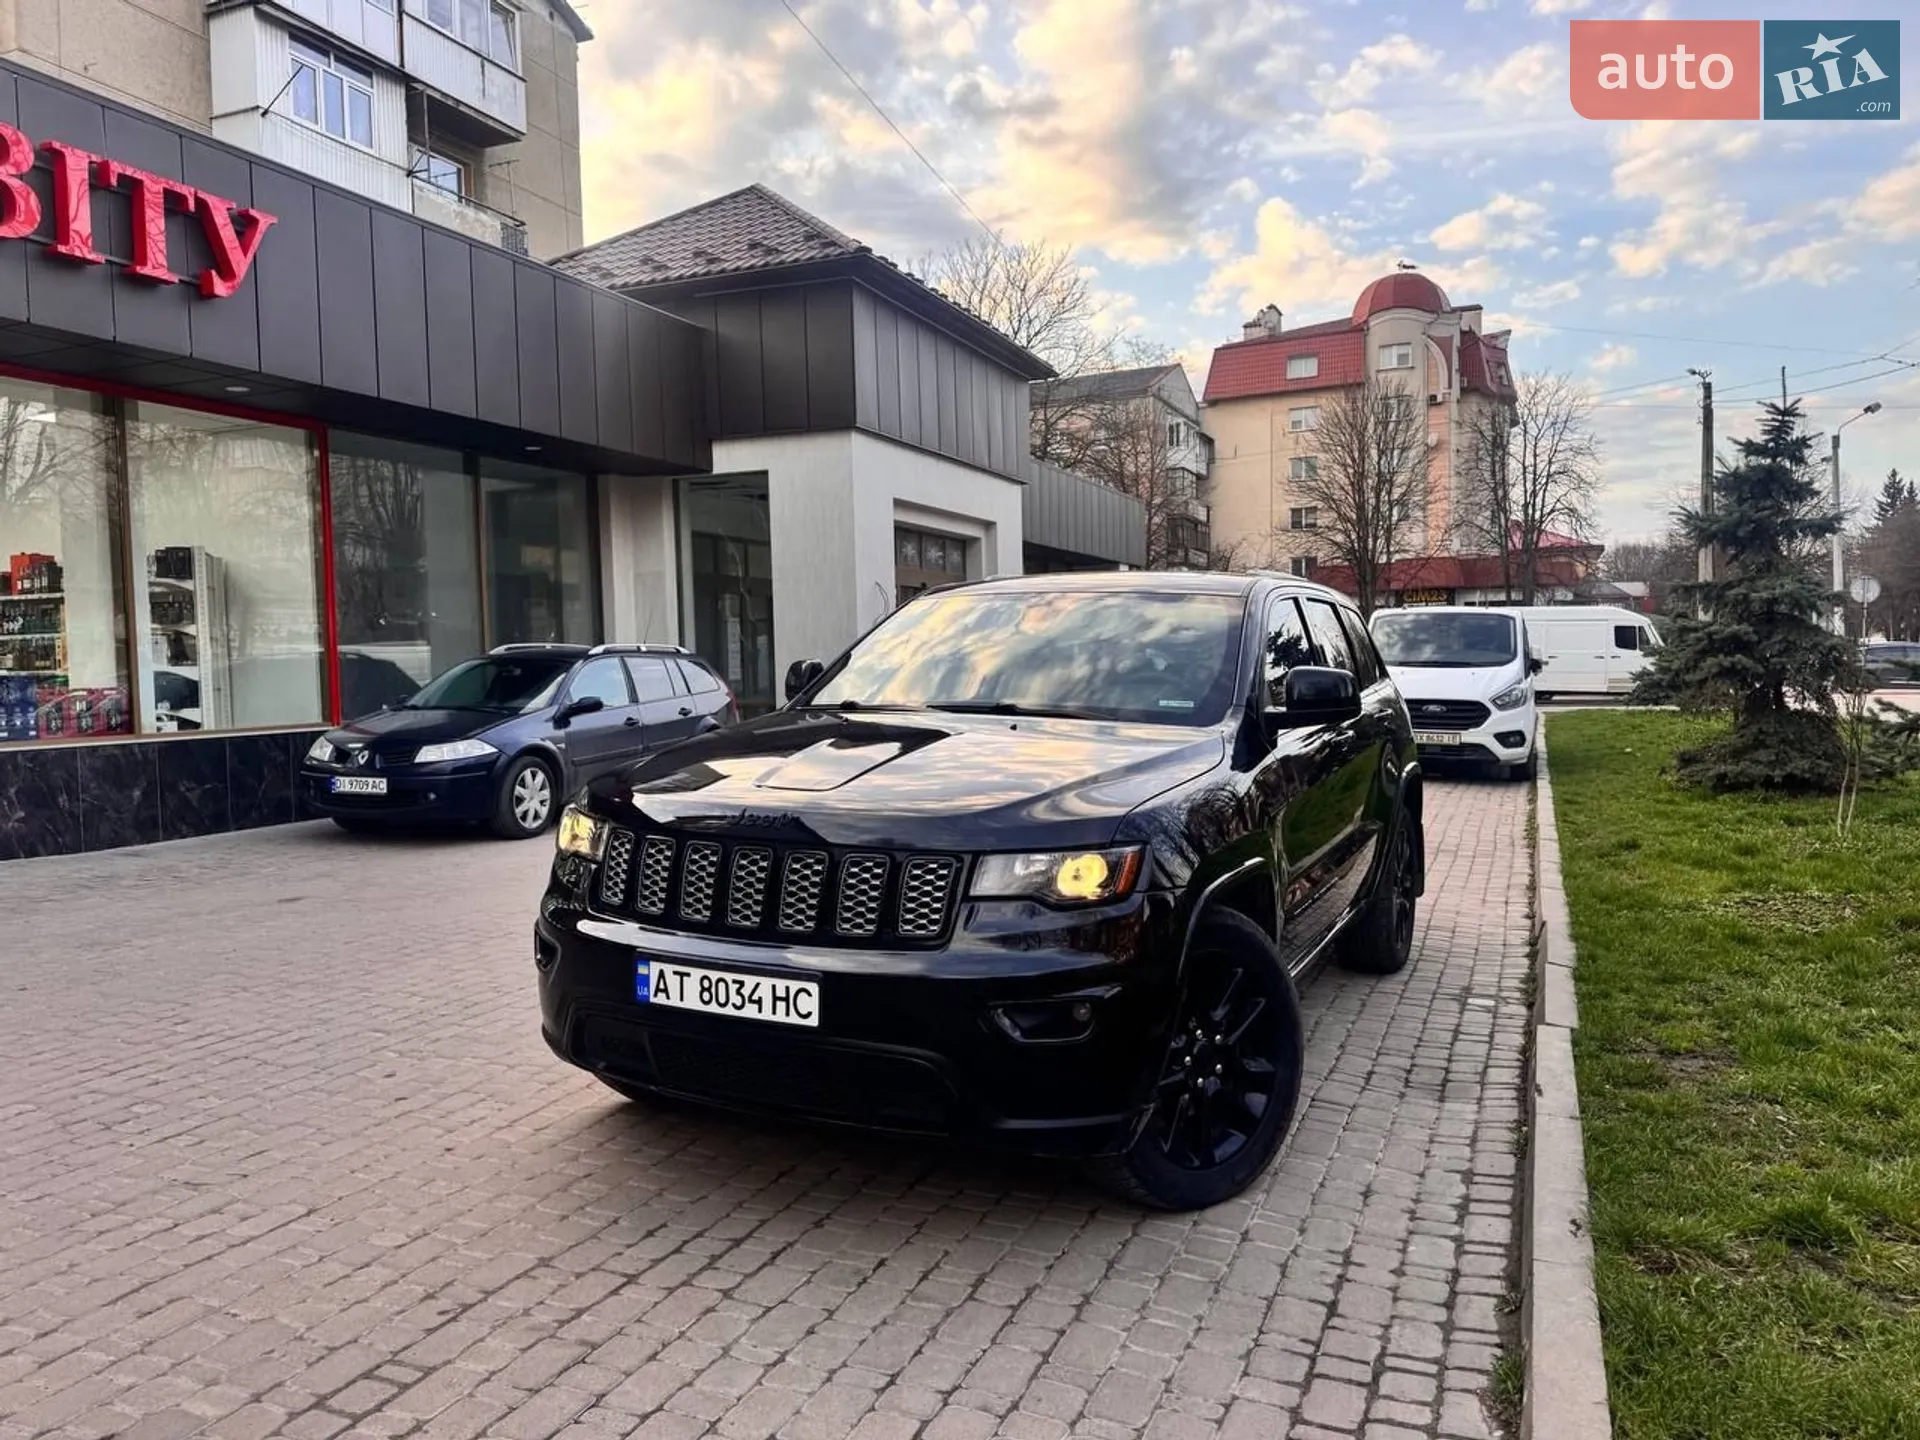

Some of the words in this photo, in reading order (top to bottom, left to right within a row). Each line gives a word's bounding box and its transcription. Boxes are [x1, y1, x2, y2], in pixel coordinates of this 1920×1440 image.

[348, 779, 370, 791] 9709
[371, 781, 385, 792] AC
[653, 968, 691, 1002] AT
[699, 974, 763, 1014] 8034
[771, 983, 813, 1020] HC
